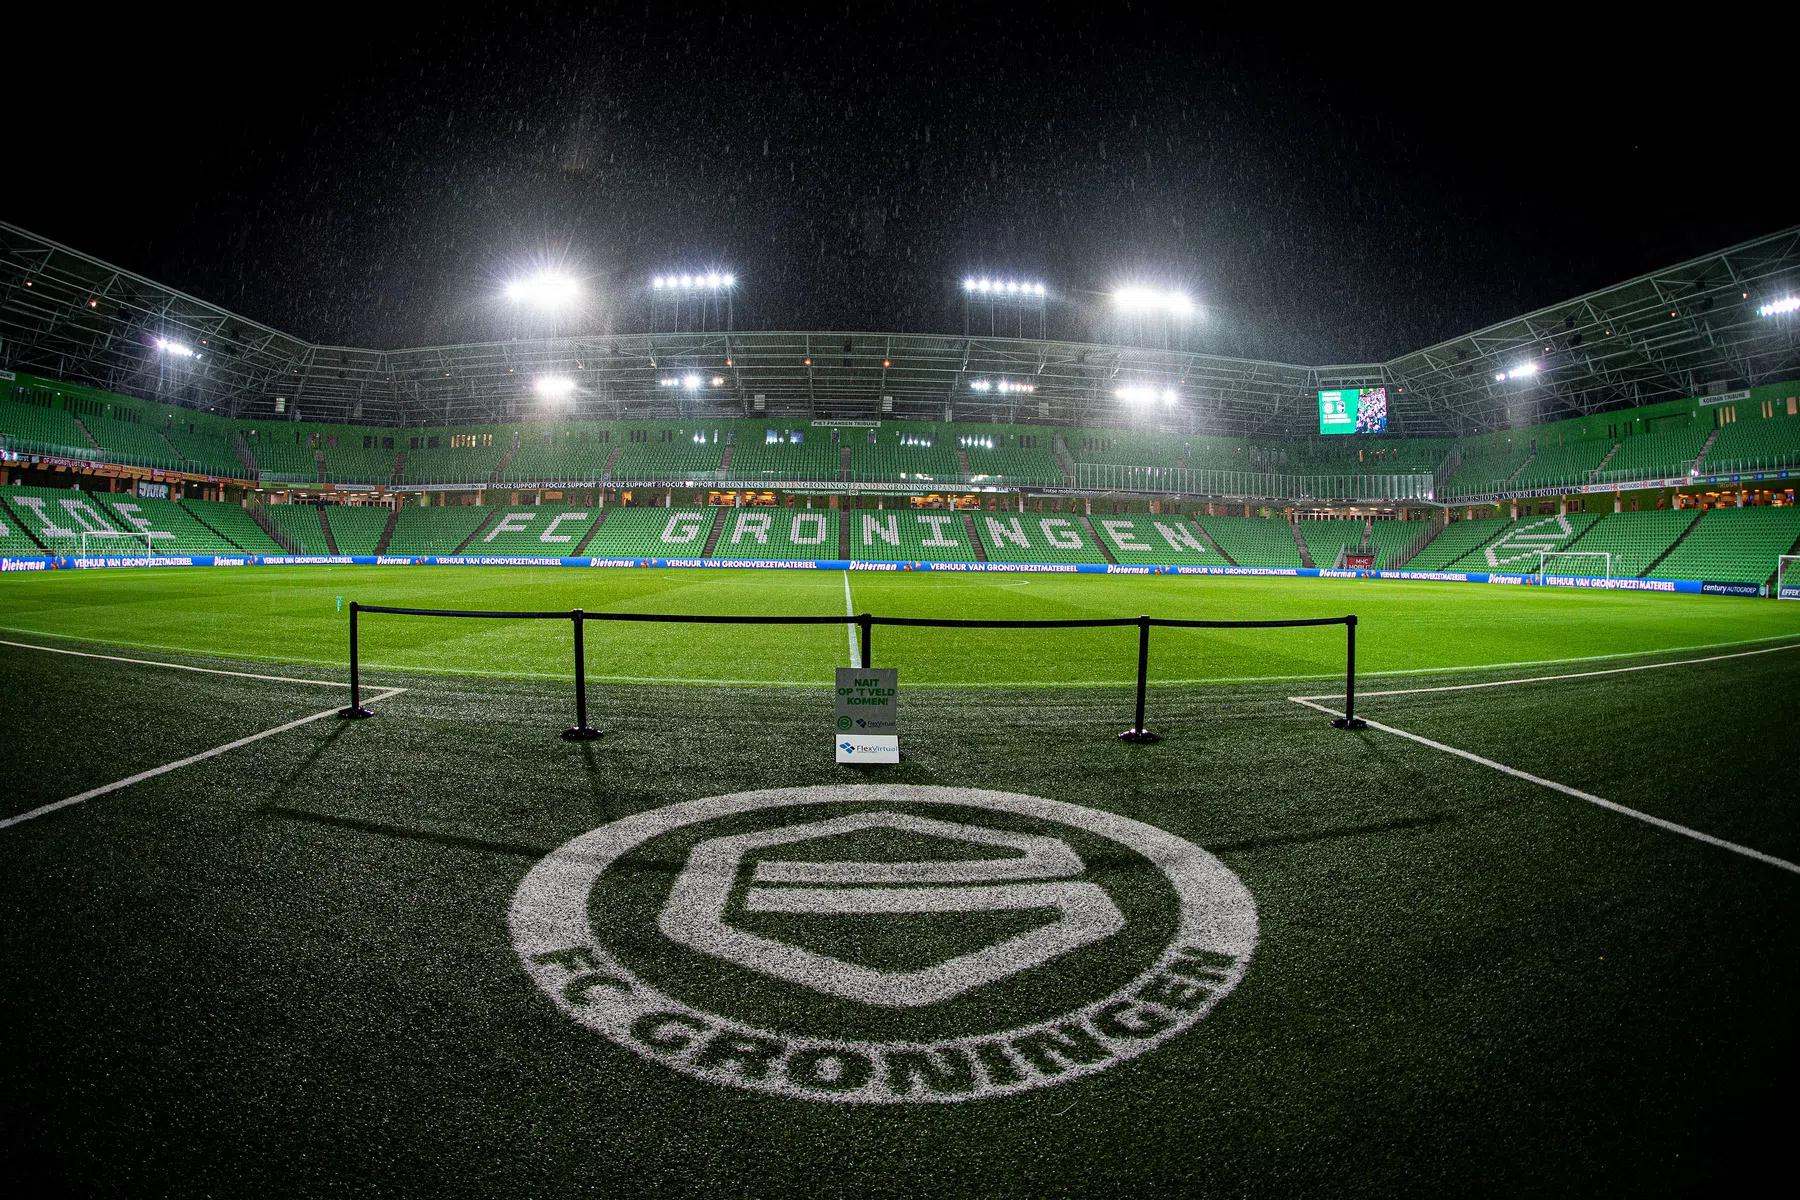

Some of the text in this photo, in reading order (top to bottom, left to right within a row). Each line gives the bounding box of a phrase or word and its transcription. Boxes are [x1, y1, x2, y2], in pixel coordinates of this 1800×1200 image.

[1702, 393, 1747, 405] KOEMAN TRIBUNE
[545, 482, 596, 490] FOCUZ SUPPORT
[604, 482, 656, 490] FOCUZ SUPPORT
[662, 482, 685, 490] FOCUZ
[1536, 486, 1582, 497] PRODUCTS
[483, 512, 1206, 552] FC GRONINGEN
[2, 558, 45, 572] Dieterman
[74, 558, 193, 568] VERHUUR VAN GRONDVERZETMATERIEEL
[213, 556, 244, 567] Dieterman
[377, 557, 411, 565] Dieterman
[466, 557, 480, 565] VAN
[481, 558, 562, 566] GRONDVERZETMATERIEEL
[590, 558, 634, 568] Dieterman
[703, 560, 720, 568] VAN
[722, 560, 817, 569] GRONDVERZETMATERIEEL
[849, 561, 897, 571] Dieterman
[930, 563, 1078, 573] VERHUUR VAN GRONDVERZETMATERIEEL
[1107, 565, 1149, 574] Dieterman
[1209, 567, 1224, 575] VAN
[1225, 568, 1298, 576] GRONDVERZETMATERIEEL
[1319, 569, 1357, 578] Dieterman
[1380, 571, 1400, 579] VERHUUR
[1488, 573, 1522, 584] Dieterman
[1546, 576, 1676, 591] VERHUUR VAN GRONDVERZETMATERIEEL
[1703, 584, 1758, 595] century AUTOGROEP
[854, 679, 879, 687] NAIT
[838, 688, 895, 696] OP 'T VELD
[847, 697, 888, 706] KOMEN!
[531, 945, 1238, 1094] FC GRONINGEN
